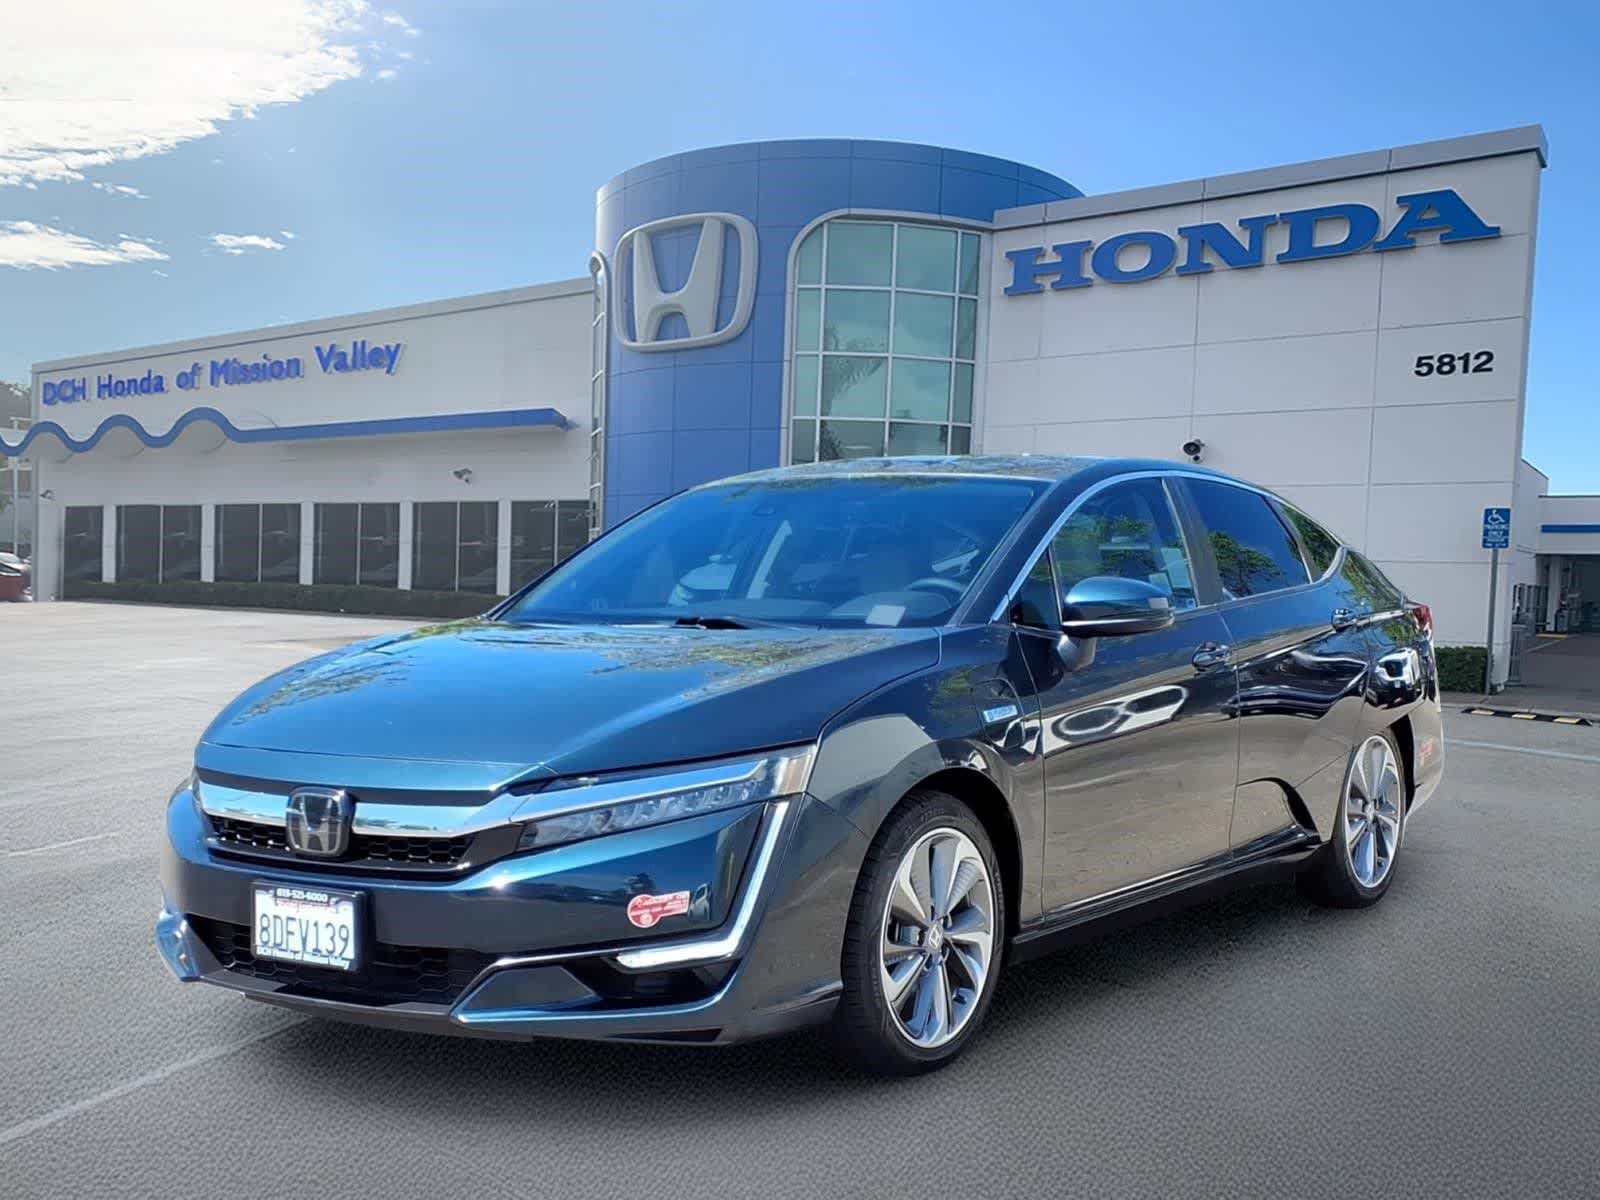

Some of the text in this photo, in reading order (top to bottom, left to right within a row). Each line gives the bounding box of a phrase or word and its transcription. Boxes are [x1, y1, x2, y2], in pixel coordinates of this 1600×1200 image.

[1004, 188, 1500, 295] HONDA
[42, 339, 404, 406] DCH Honda of Mission Valley
[1414, 351, 1494, 376] 5812
